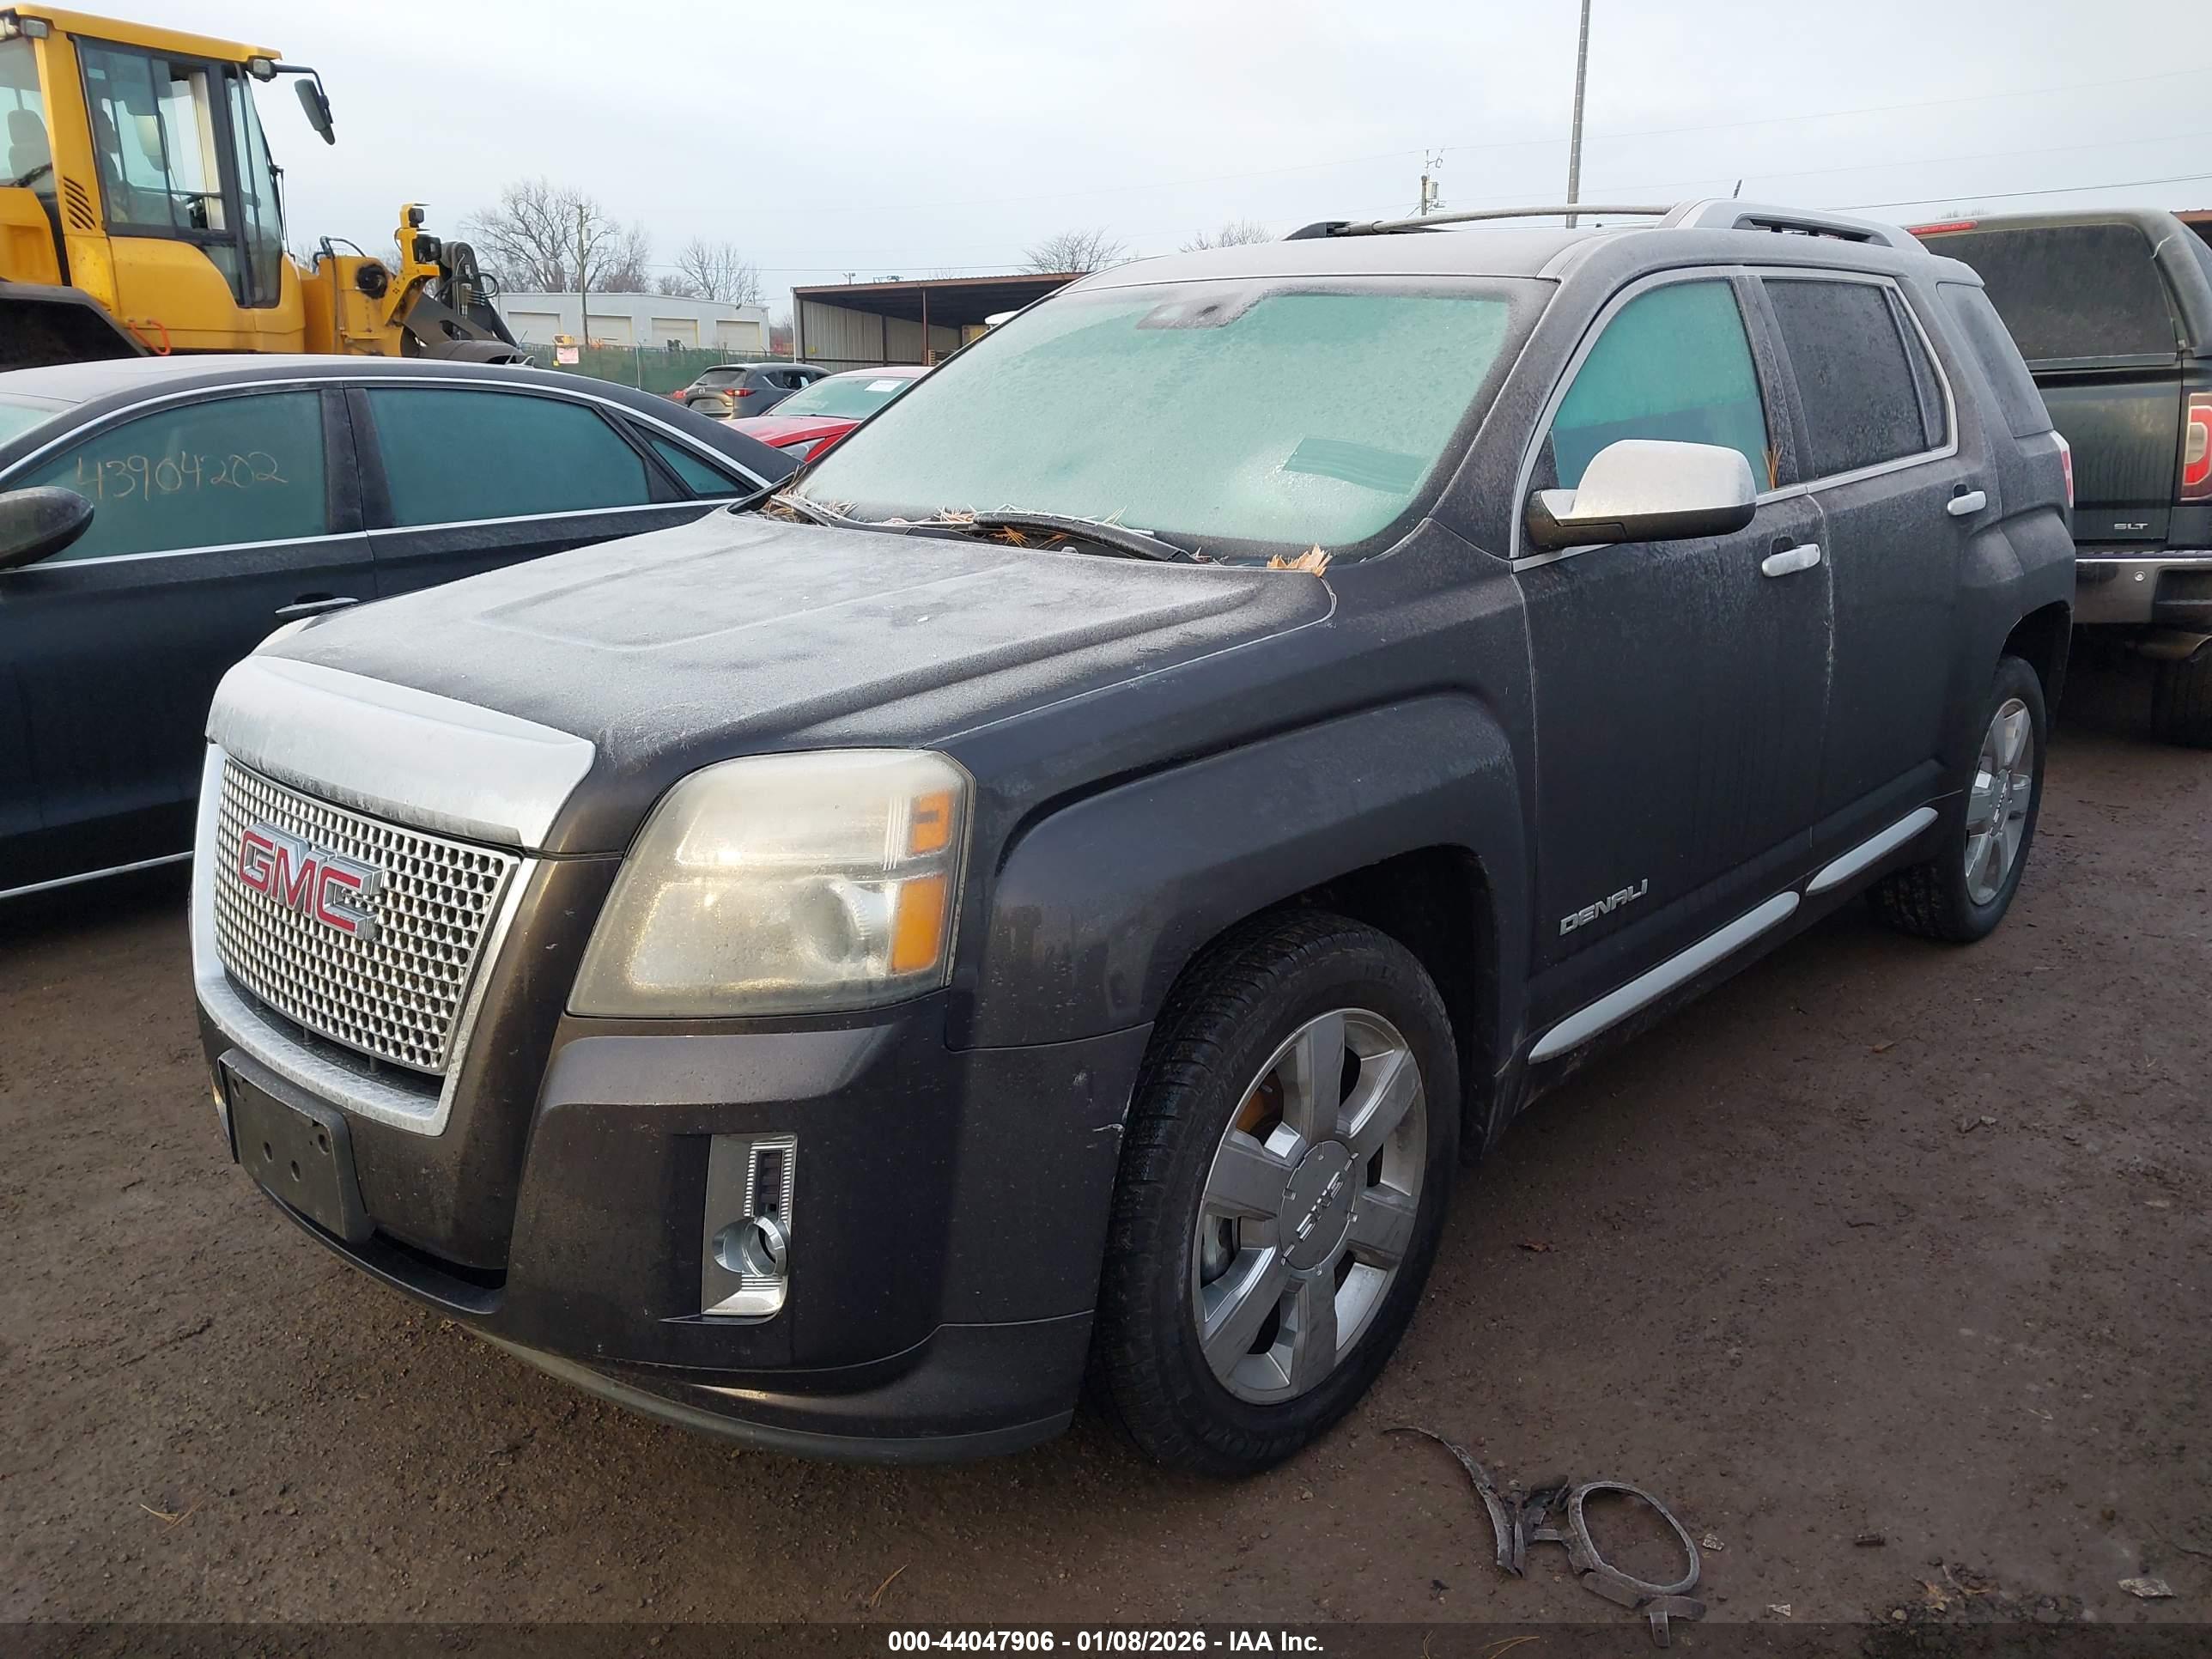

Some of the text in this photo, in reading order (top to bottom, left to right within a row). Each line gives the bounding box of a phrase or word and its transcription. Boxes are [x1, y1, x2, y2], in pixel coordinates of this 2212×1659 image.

[76, 450, 289, 501] 43904202
[238, 827, 378, 939] GMC
[1559, 878, 1648, 936] DENALI
